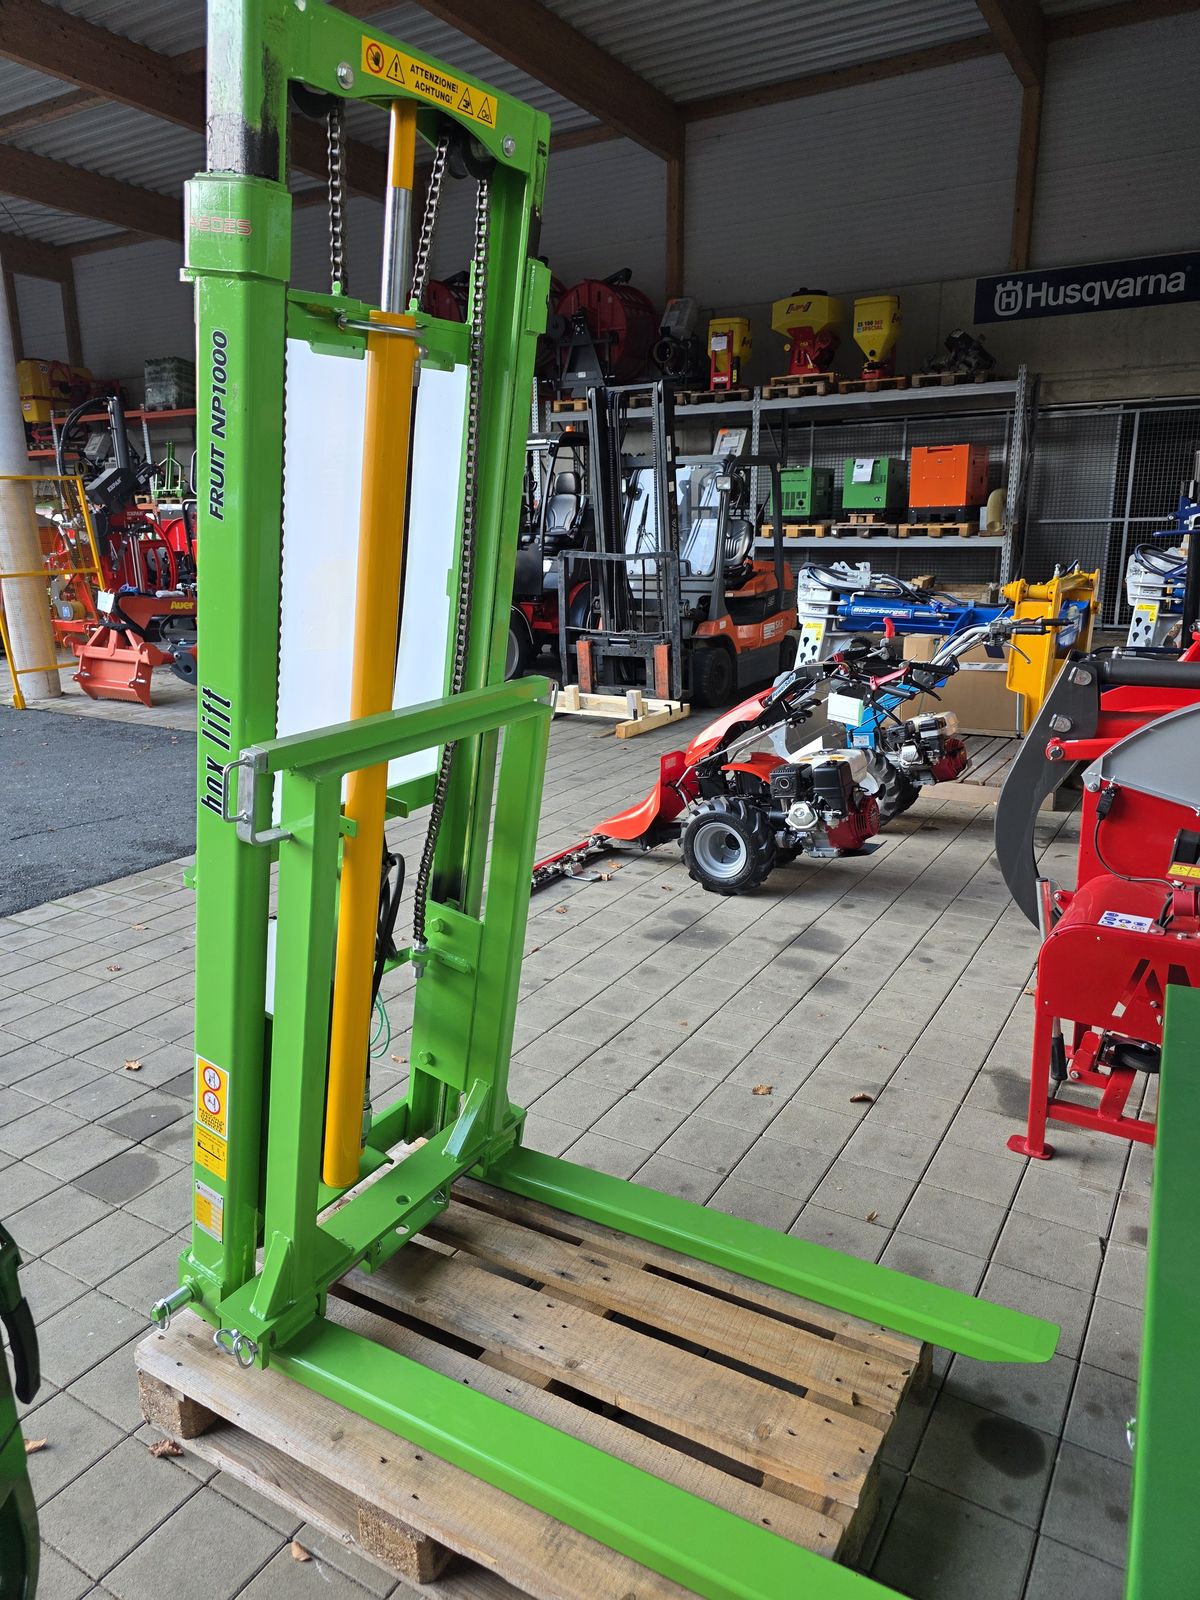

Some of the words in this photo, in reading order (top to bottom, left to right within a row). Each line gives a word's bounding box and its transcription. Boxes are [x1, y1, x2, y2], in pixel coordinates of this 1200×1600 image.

[410, 64, 459, 94] ATTENZIONE!
[415, 81, 453, 105] ACHTUNG!
[1025, 271, 1186, 309] Husqvarna
[211, 330, 228, 440] NP1000
[209, 443, 226, 521] FRUIT
[170, 600, 194, 610] Auer
[201, 686, 231, 752] lift
